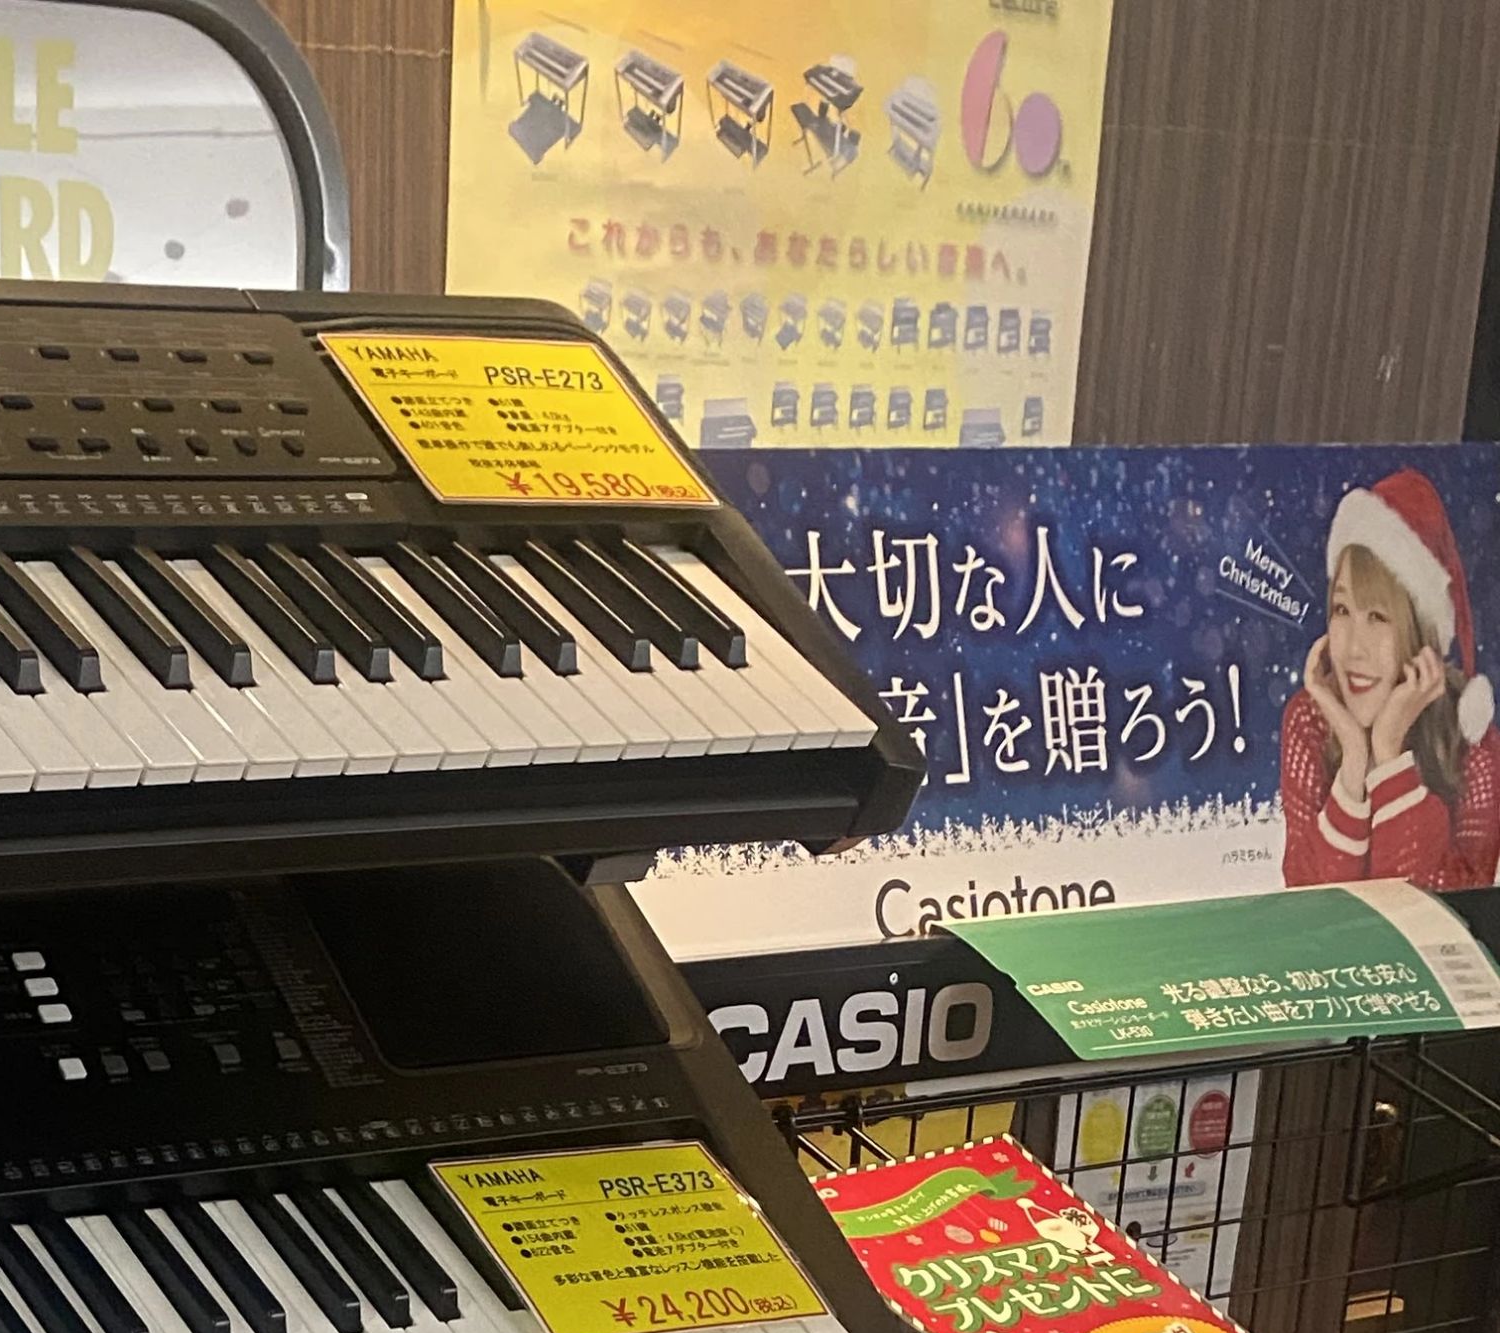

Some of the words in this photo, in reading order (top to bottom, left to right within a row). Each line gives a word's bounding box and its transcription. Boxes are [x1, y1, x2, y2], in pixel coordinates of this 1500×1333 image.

[348, 346, 439, 362] YAMAHA
[484, 366, 604, 390] PSR-E273
[784, 525, 1146, 641] 大切な人に
[1244, 538, 1296, 589] Merry
[1219, 555, 1310, 623] Christmas!
[1027, 980, 1084, 996] CASIO
[1067, 997, 1148, 1016] Casiotone
[709, 983, 994, 1085] CASIO
[459, 1168, 545, 1189] YAMAHA
[599, 1170, 716, 1200] PSR-E373
[898, 1240, 1078, 1297] クリスマス
[934, 1267, 1154, 1330] プレゼントに
